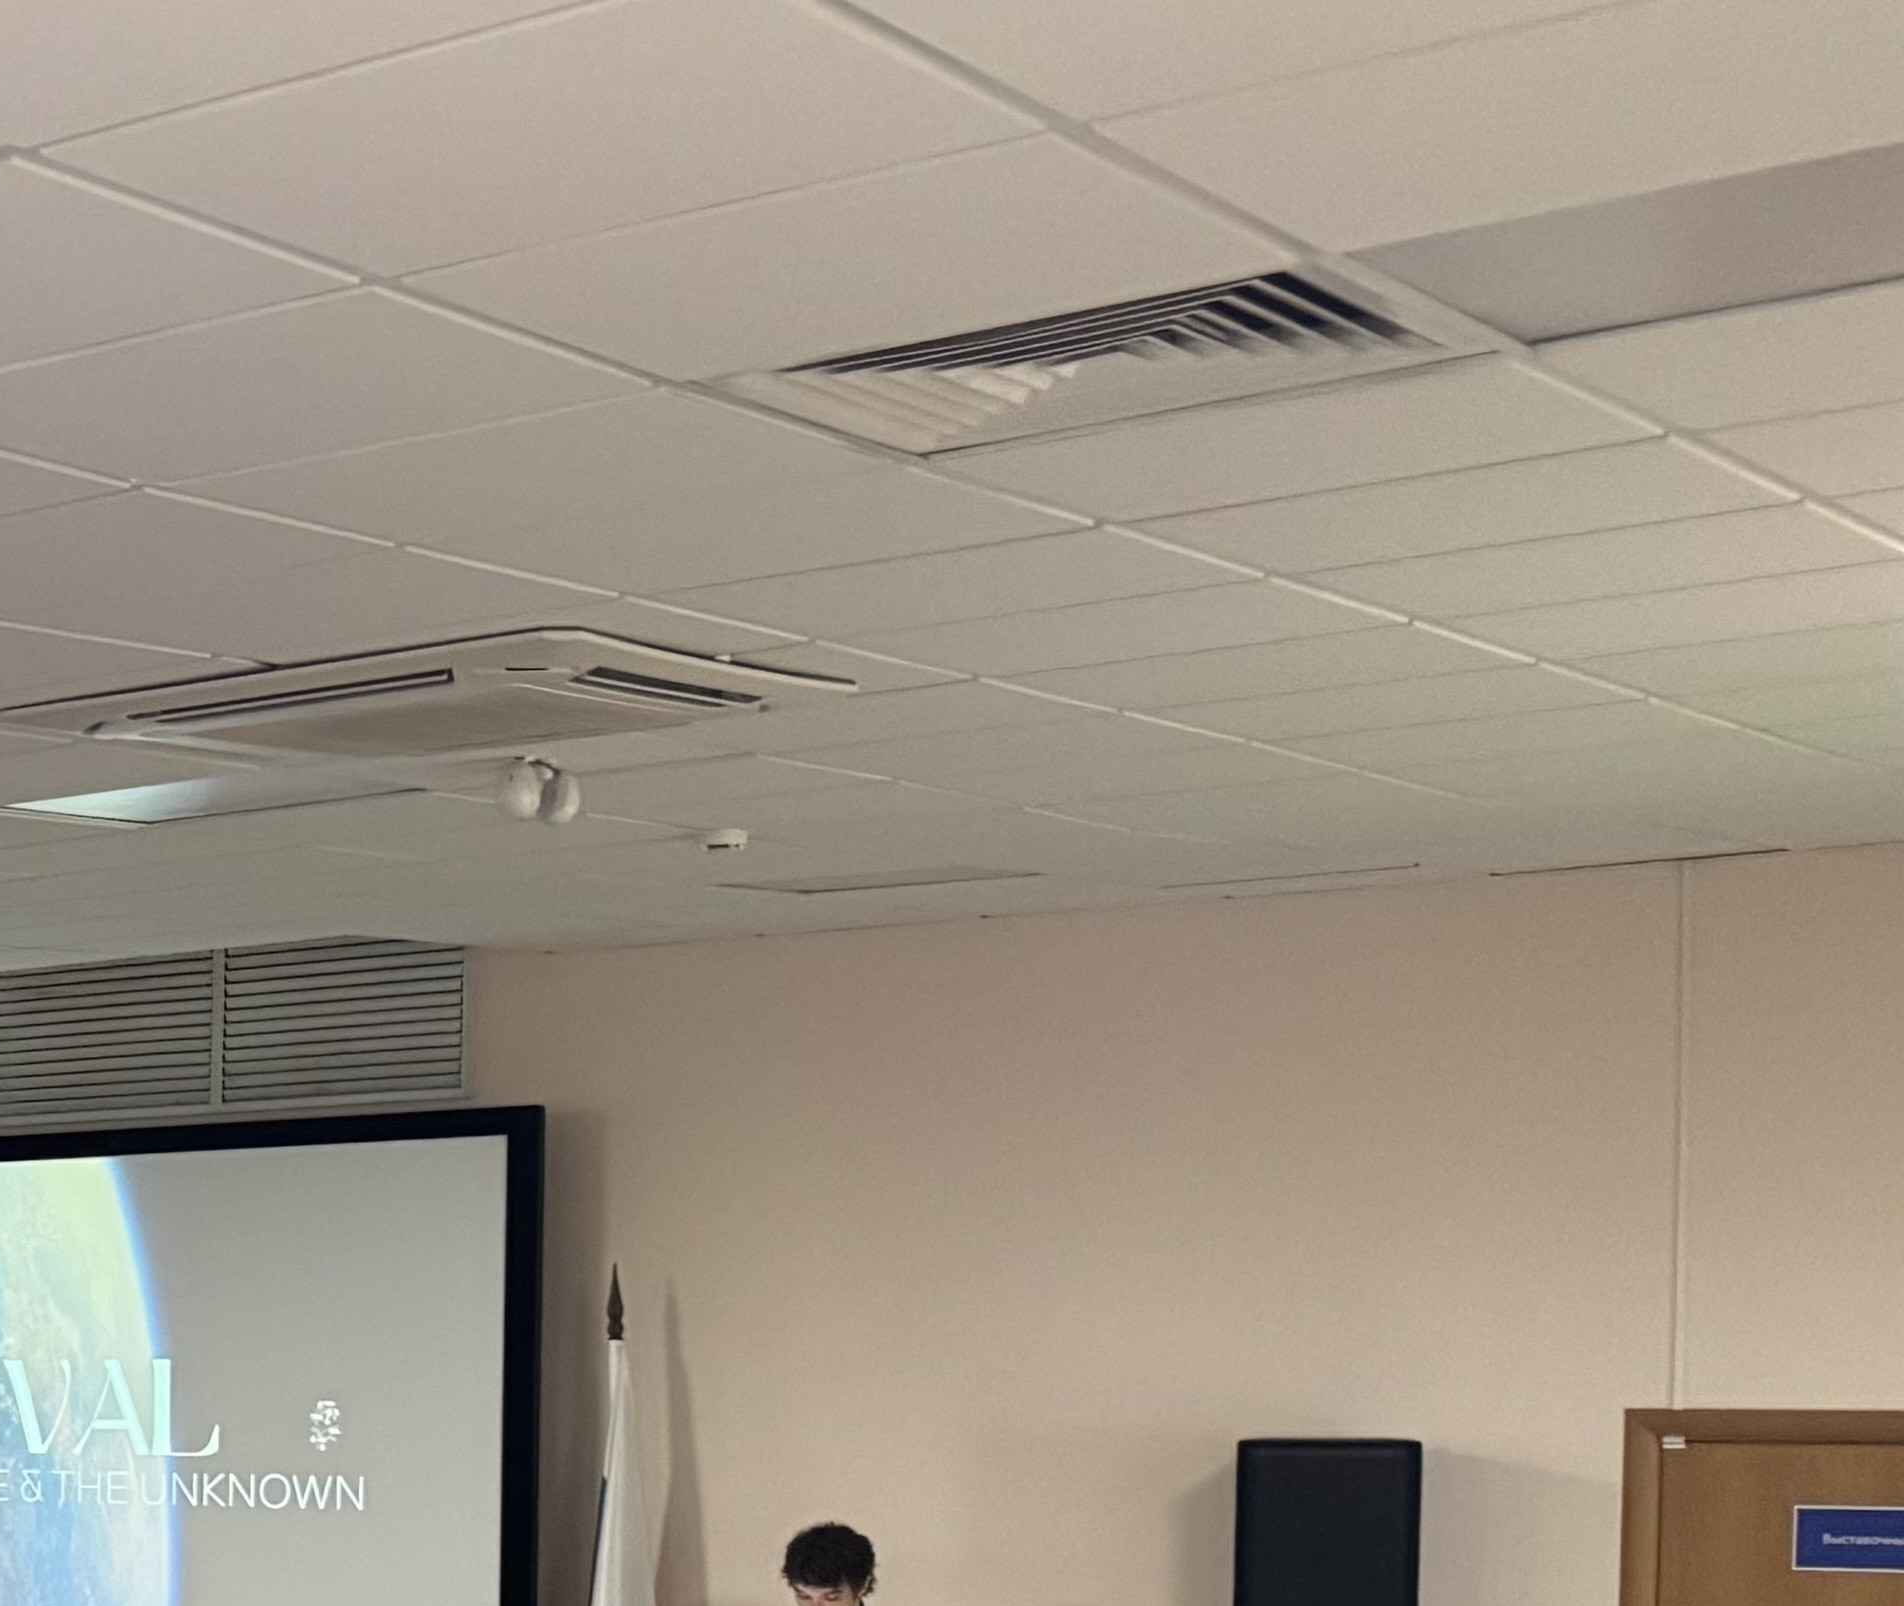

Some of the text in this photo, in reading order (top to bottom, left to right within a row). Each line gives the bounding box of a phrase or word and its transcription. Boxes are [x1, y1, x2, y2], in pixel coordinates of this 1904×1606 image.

[20, 1469, 45, 1503] &
[49, 1469, 129, 1507] THE
[141, 1472, 365, 1511] UNKNOWN
